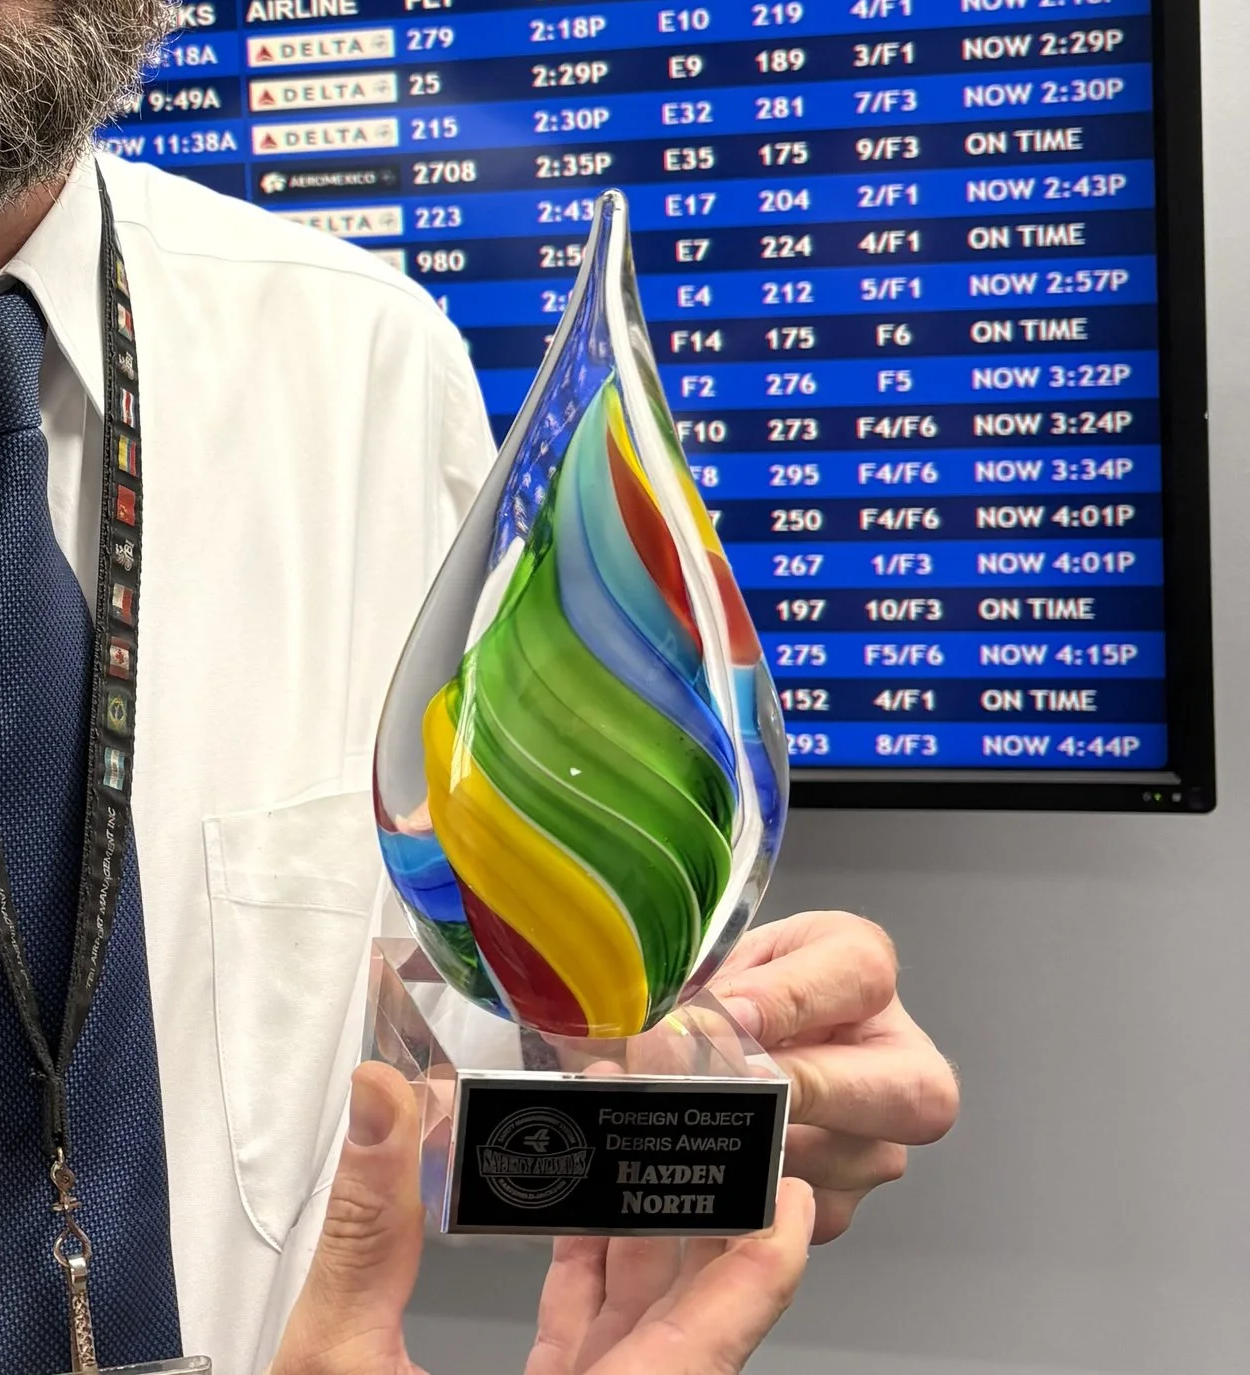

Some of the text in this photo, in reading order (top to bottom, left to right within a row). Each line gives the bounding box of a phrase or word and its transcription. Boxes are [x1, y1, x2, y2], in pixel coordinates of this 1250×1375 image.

[281, 39, 364, 59] DELTA
[406, 27, 454, 51] 279
[529, 15, 606, 42] 2:18P
[658, 8, 710, 33] E10
[752, 1, 803, 27] 219
[153, 43, 218, 68] :18A
[283, 29, 1124, 103] DELTA 25 2:29P E9 189 3/F1 NOW 2:29P
[148, 87, 222, 112] 9:49A
[285, 78, 1124, 146] DELTA 215 2:30P E32 281 7/F3 NOW 2:30P
[153, 130, 237, 155] 11:38A
[413, 160, 477, 185] 2708
[535, 152, 612, 179] 2:35P
[663, 147, 715, 172] E35
[760, 141, 808, 166] 175
[855, 135, 920, 161] 9/F3
[965, 131, 1007, 156] ON
[1013, 127, 1083, 153] TIME
[415, 206, 462, 229] 223
[537, 200, 594, 223] 2:43
[665, 192, 717, 217] E17
[759, 189, 810, 213] 204
[857, 183, 918, 208] 2/F1
[967, 178, 1035, 202] NOW
[1043, 173, 1126, 199] 2:43P
[416, 222, 1085, 273] 980 2:5 E7 224 4/F1 ON TIME
[677, 269, 1128, 308] E4 212 5/F1 NOW 2:57P
[671, 317, 1087, 353] F14 175 F6 ON TIME
[681, 363, 1131, 398] F2 276 F5 NOW 3:22P
[676, 410, 1132, 443] F10 273 F4/F6 NOW 3:24P
[769, 463, 820, 487] 295
[858, 462, 938, 485] F4/F6
[975, 460, 1043, 482] NOW
[1052, 458, 1133, 481] 3:34P
[772, 509, 823, 532] 250
[860, 507, 940, 531] F4/F6
[977, 506, 1044, 529] NOW
[1052, 504, 1134, 527] 4:01P
[773, 551, 1135, 577] 267 1/F3 NOW 4:01P
[777, 597, 1095, 621] 197 10/F3 ON TIME
[777, 644, 1137, 666] 275 F5/F6 NOW 4:15P
[780, 689, 1096, 712] 152 4/F1 ON TIME
[876, 734, 937, 756] 8/F3
[983, 735, 1050, 756] NOW
[1058, 736, 1139, 756] 4:44P
[108, 806, 116, 830] INC
[599, 1108, 755, 1127] FOREIGN OBJECT
[606, 1134, 742, 1152] DEBRIS AWARD
[616, 1160, 726, 1185] HAYDEN
[621, 1191, 716, 1215] NORTH
